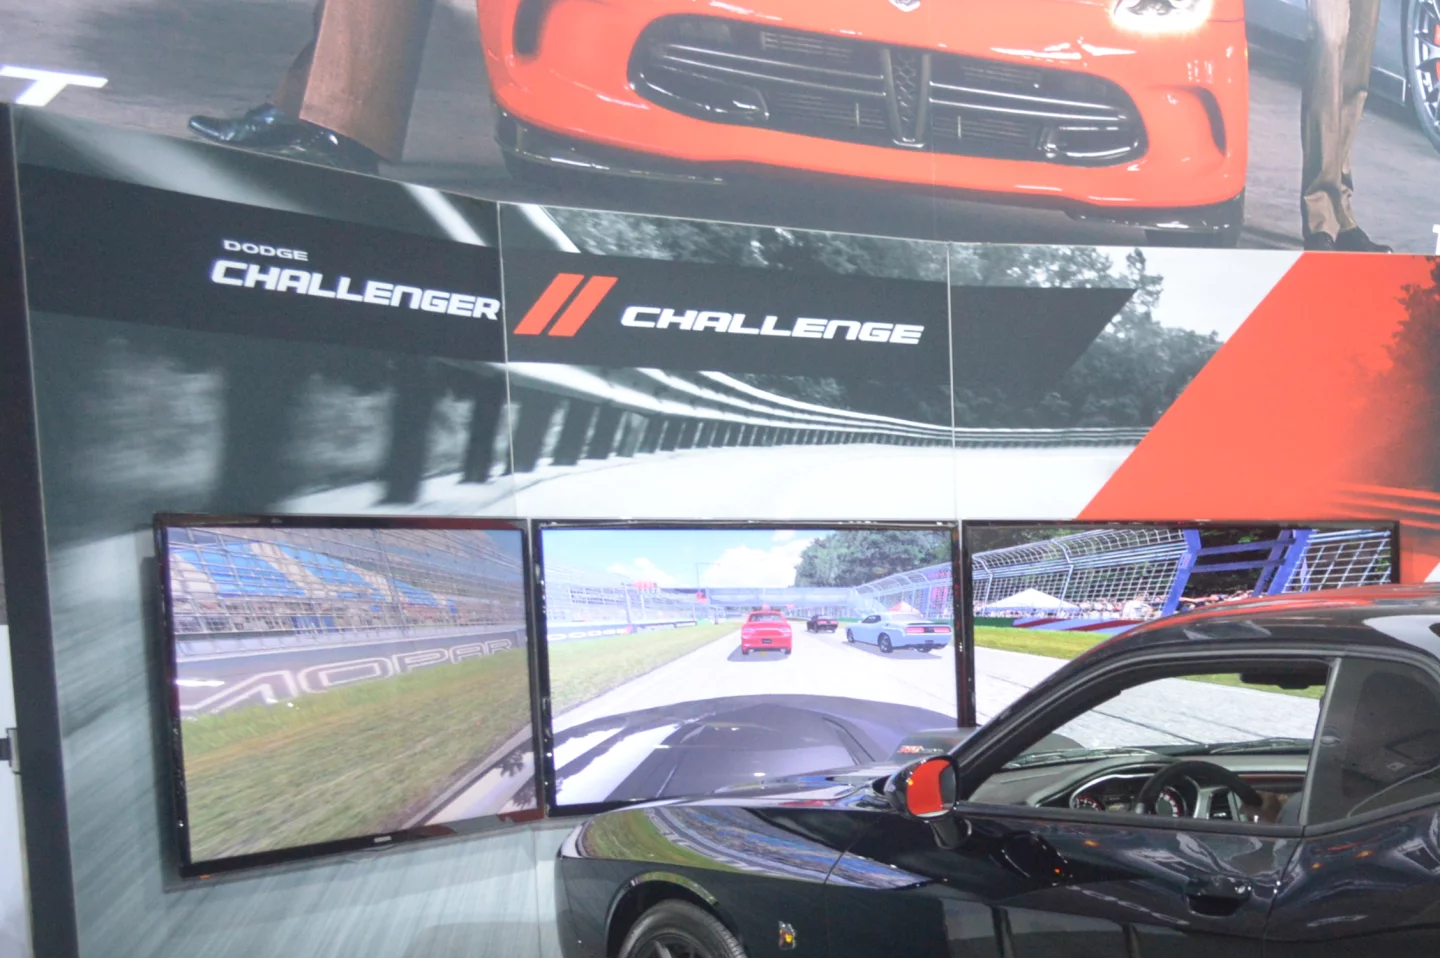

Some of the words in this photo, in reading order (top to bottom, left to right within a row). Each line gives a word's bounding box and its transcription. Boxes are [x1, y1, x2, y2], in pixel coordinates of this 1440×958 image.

[223, 239, 309, 261] DODGE
[210, 259, 501, 320] CHALLENGER
[620, 305, 925, 345] CHALLENGE
